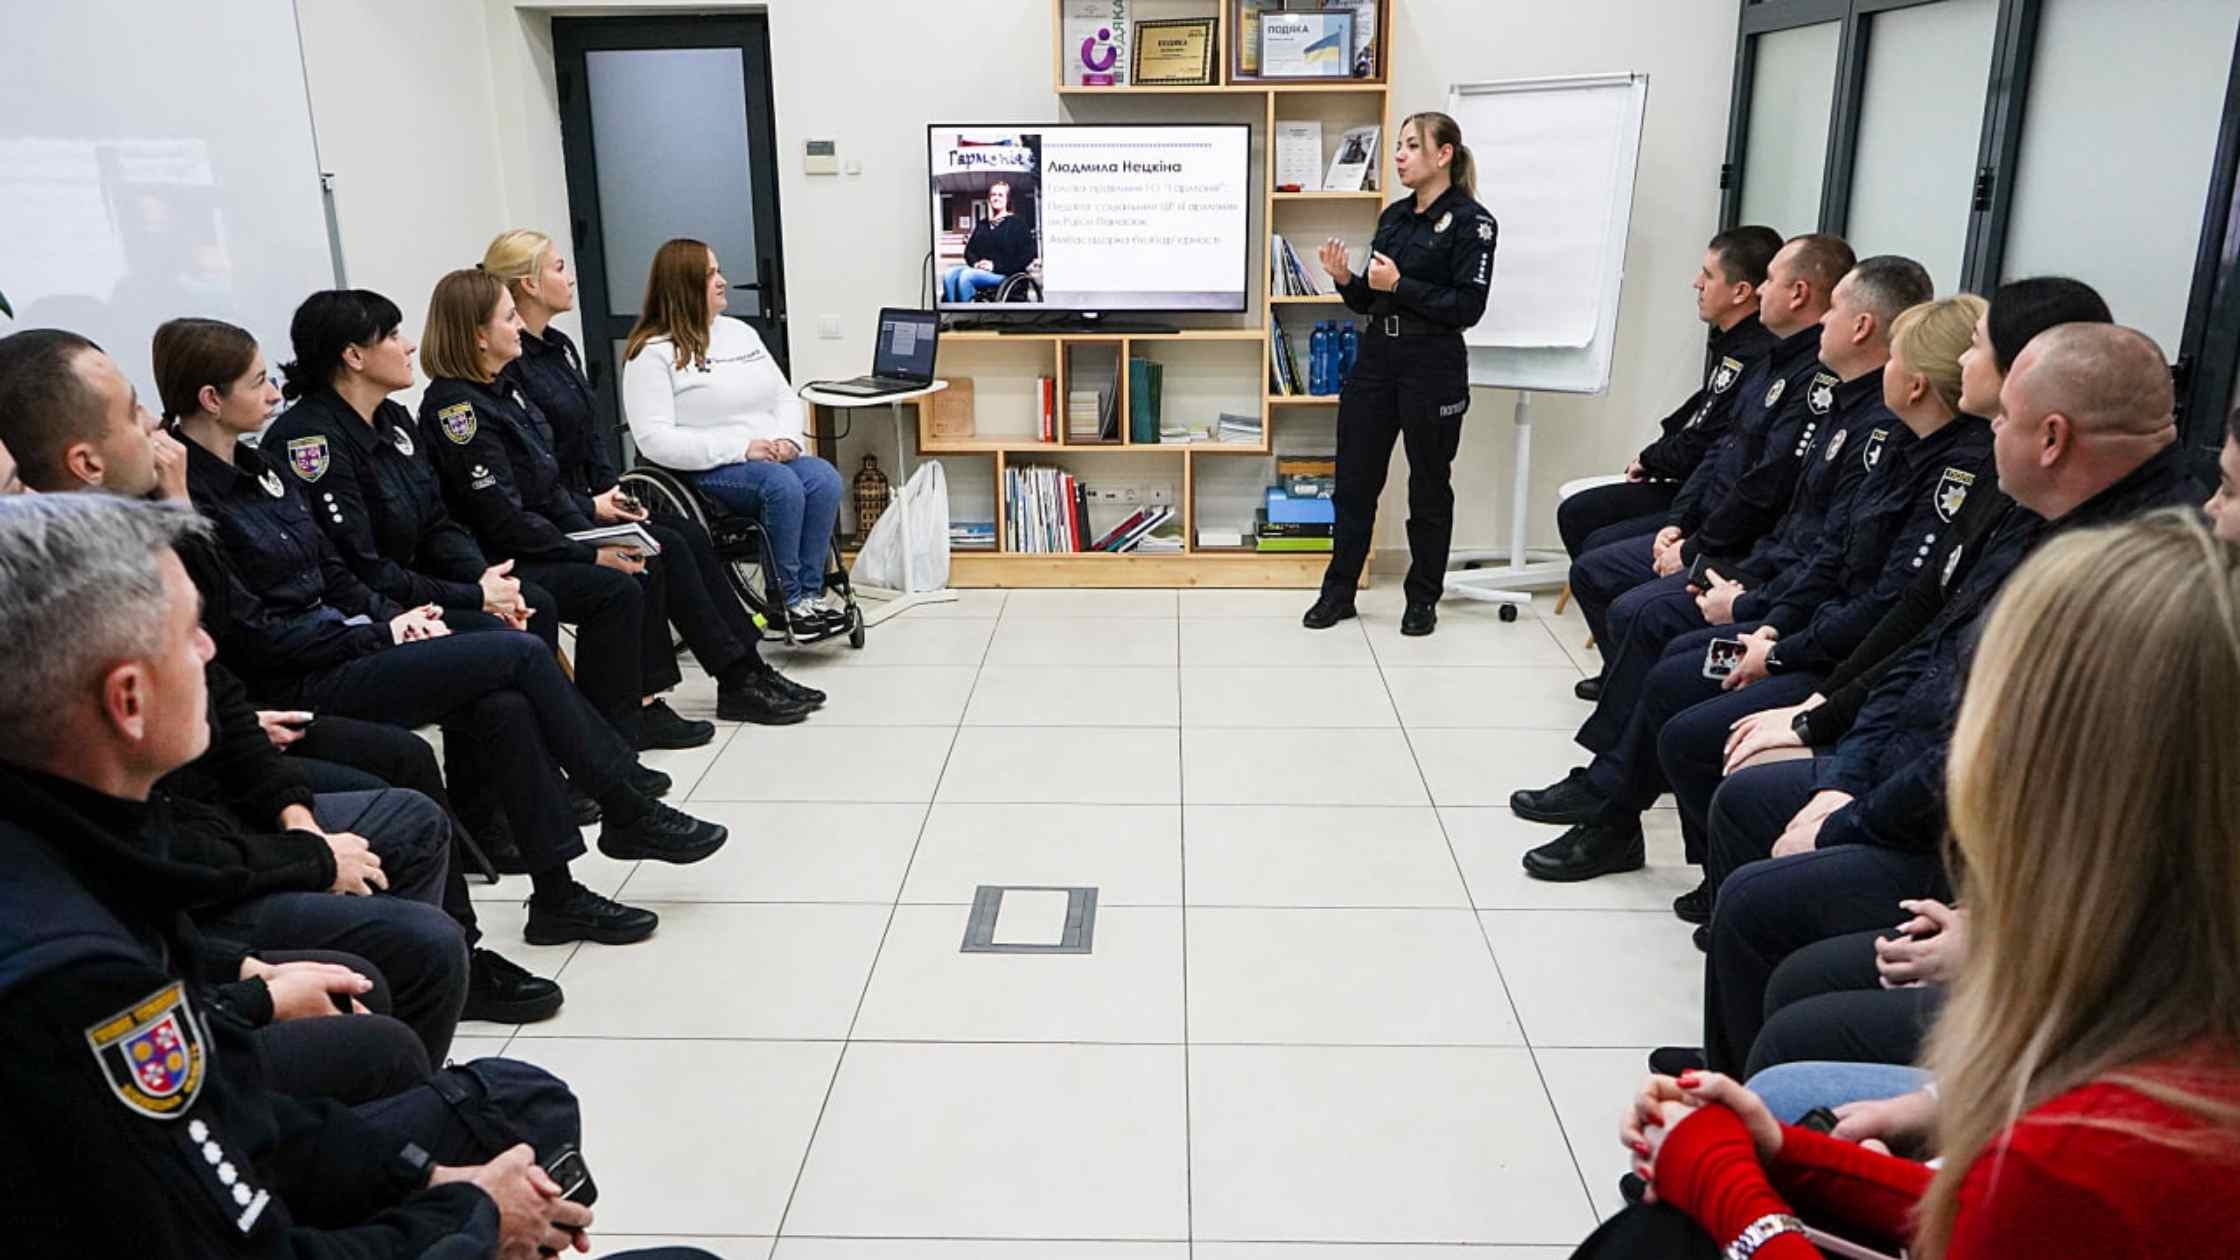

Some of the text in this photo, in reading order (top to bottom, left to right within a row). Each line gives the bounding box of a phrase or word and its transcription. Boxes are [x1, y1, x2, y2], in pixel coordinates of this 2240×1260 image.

[1268, 25, 1309, 34] ПОДЯКА
[1047, 159, 1183, 174] Людмила Нецкіна
